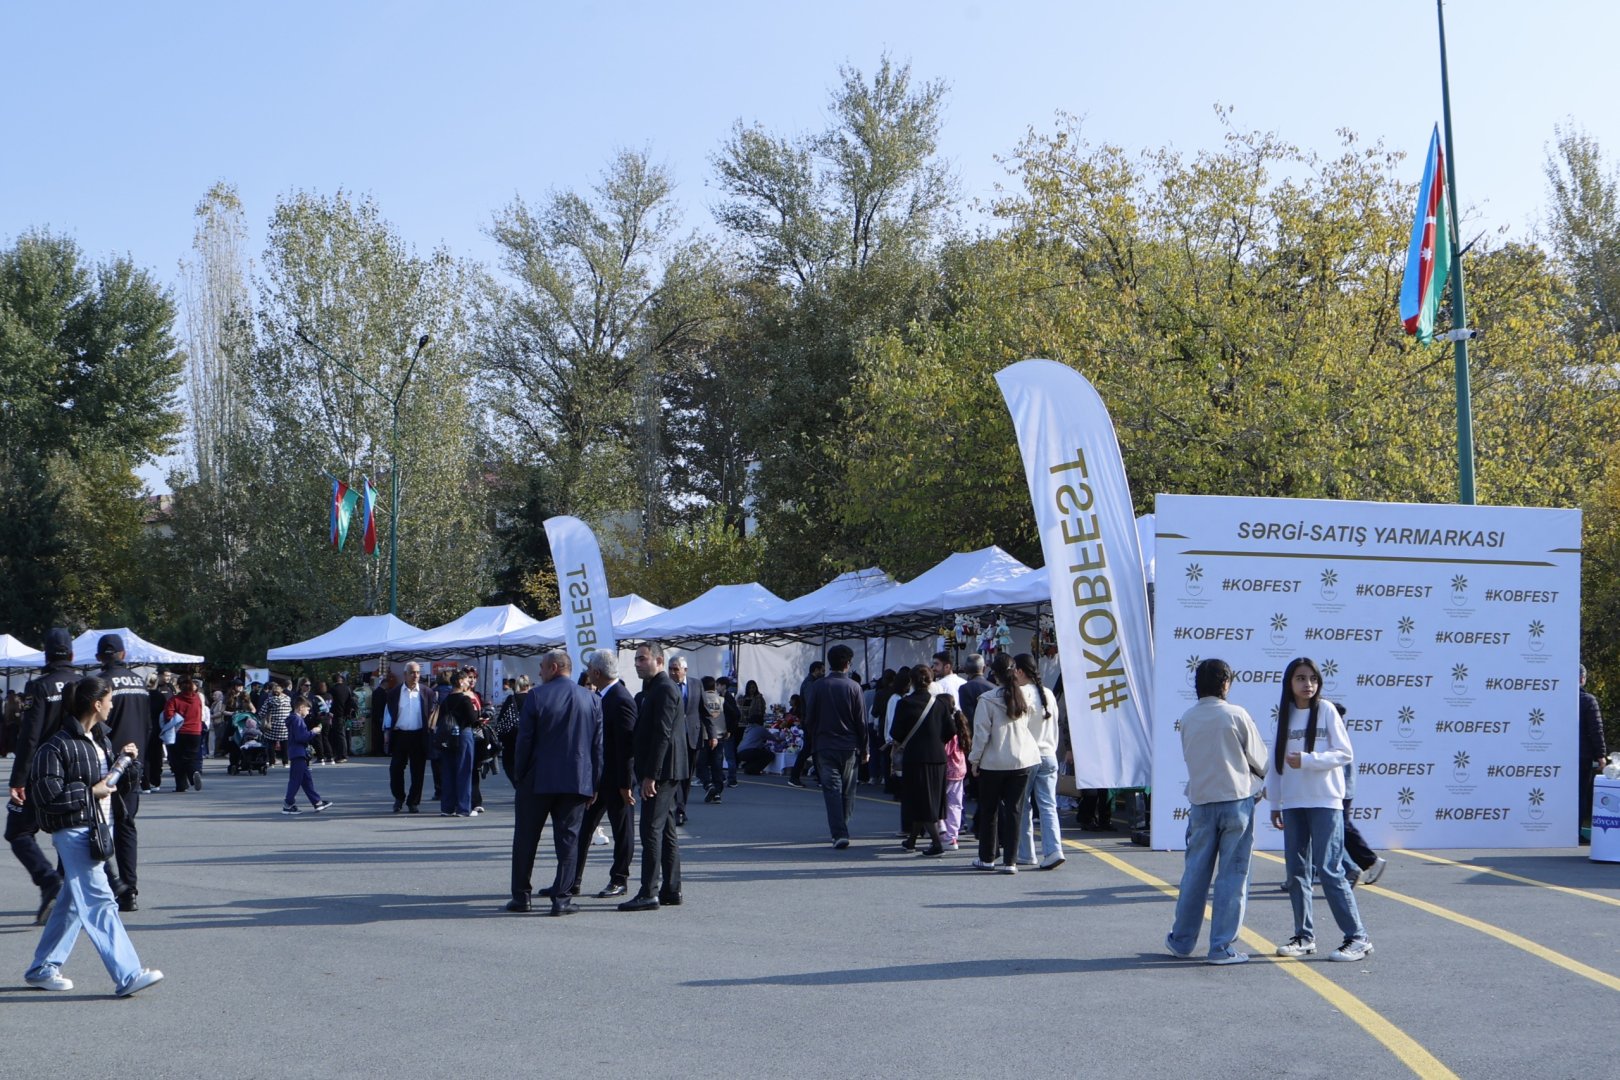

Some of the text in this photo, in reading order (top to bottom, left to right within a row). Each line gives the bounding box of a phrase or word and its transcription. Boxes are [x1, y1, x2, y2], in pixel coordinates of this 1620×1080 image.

[1237, 520, 1505, 548] SƏRGİ-SATIŞ YARMARKASI
[1222, 578, 1301, 593] #KOBFEST
[1355, 583, 1433, 598] #KOBFEST
[1484, 588, 1559, 603] #KOBFEST
[1173, 626, 1254, 641] #KOBFEST
[1304, 627, 1383, 642] #KOBFEST
[1435, 630, 1511, 645] #KOBFEST
[1231, 670, 1283, 684] KOBFE
[1356, 673, 1434, 688] #KOBFEST
[1485, 677, 1560, 692] #KOBFEST
[1346, 718, 1383, 733] FEST
[1435, 720, 1511, 734] #KOBFEST
[1357, 762, 1436, 776] #KOBFEST
[1486, 764, 1561, 778] #KOBFEST
[1434, 807, 1511, 821] #KOBFEST
